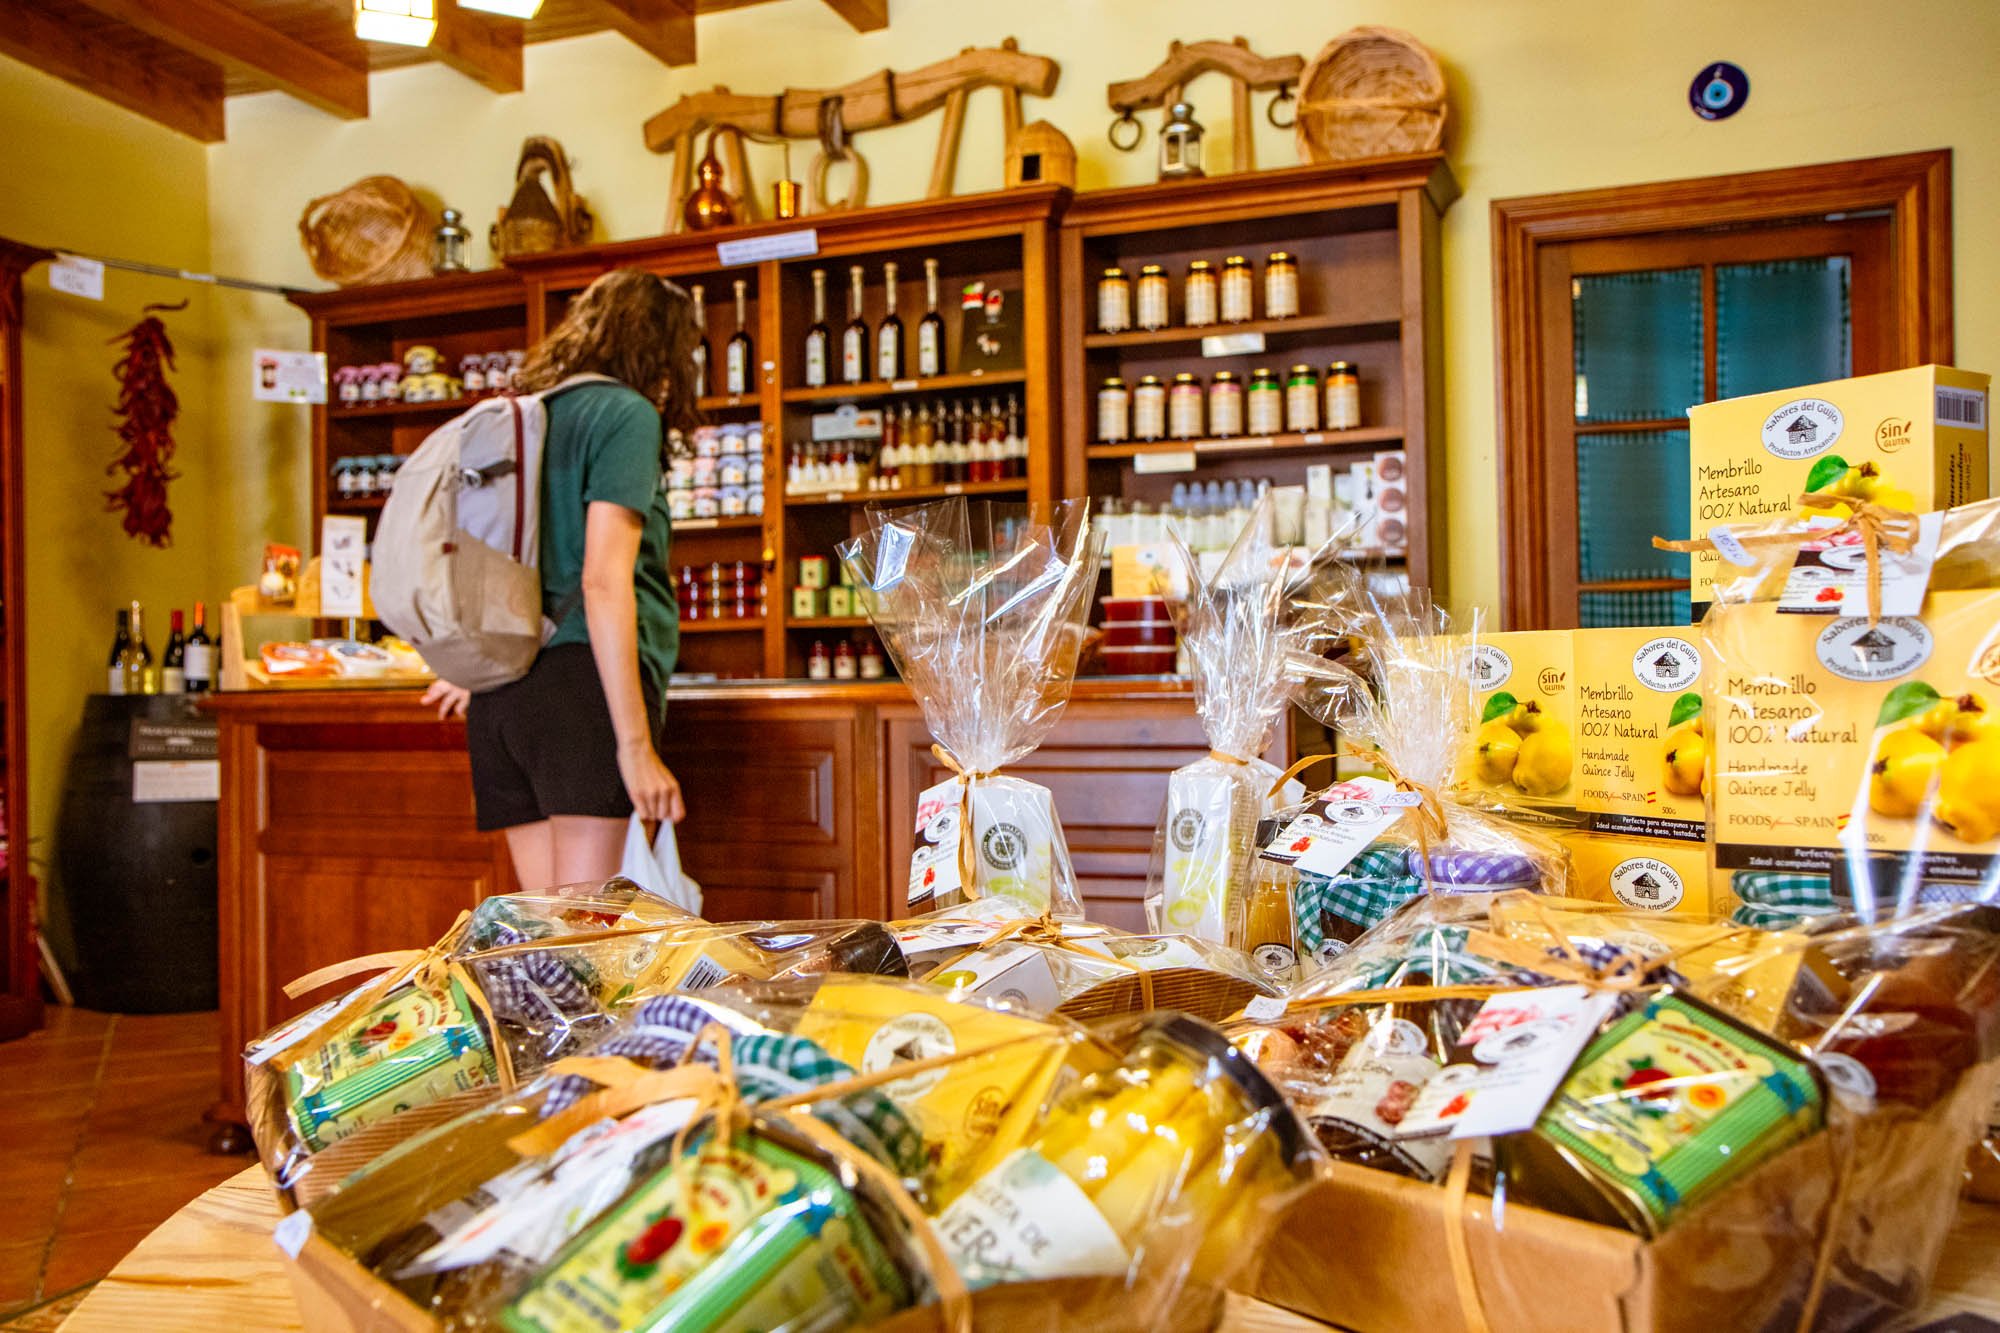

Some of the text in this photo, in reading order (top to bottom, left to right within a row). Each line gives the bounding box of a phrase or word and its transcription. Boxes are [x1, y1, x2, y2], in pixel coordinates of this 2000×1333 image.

[1766, 405, 1799, 432] Sabores
[1801, 402, 1815, 411] del
[1881, 423, 1902, 438] sin
[1768, 432, 1836, 456] Productos Artesanos
[1884, 437, 1911, 447] GLUTEN
[1699, 457, 1762, 481] Membrillo
[1699, 483, 1760, 501] Artesano
[1699, 493, 1791, 521] 100% Natural
[1636, 641, 1665, 663] Sabores
[1666, 640, 1679, 649] del
[1481, 673, 1507, 690] Artesanos
[1542, 671, 1559, 684] sin
[1638, 671, 1696, 689] Productos Artesanos
[1728, 672, 1817, 696] Membrillo
[1580, 682, 1634, 700] Membrillo
[1581, 703, 1632, 720] Artesano
[1581, 722, 1659, 739] 100% Natural
[1581, 747, 1630, 762] Handmade
[1582, 763, 1635, 782] Quince Jelly
[1728, 759, 1808, 776] Handmade
[1583, 789, 1609, 799] FOODS
[1622, 792, 1646, 801] SPAIN
[1728, 780, 1816, 802] Quince Jelly
[1647, 819, 1660, 827] para
[1661, 820, 1689, 830] desayunos
[1729, 814, 1772, 826] FOODS
[1795, 816, 1835, 828] SPAIN
[1749, 857, 1773, 866] Ideal
[1614, 862, 1644, 881] Sabores
[1646, 861, 1659, 871] del
[1616, 889, 1677, 911] Productos Artesanos
